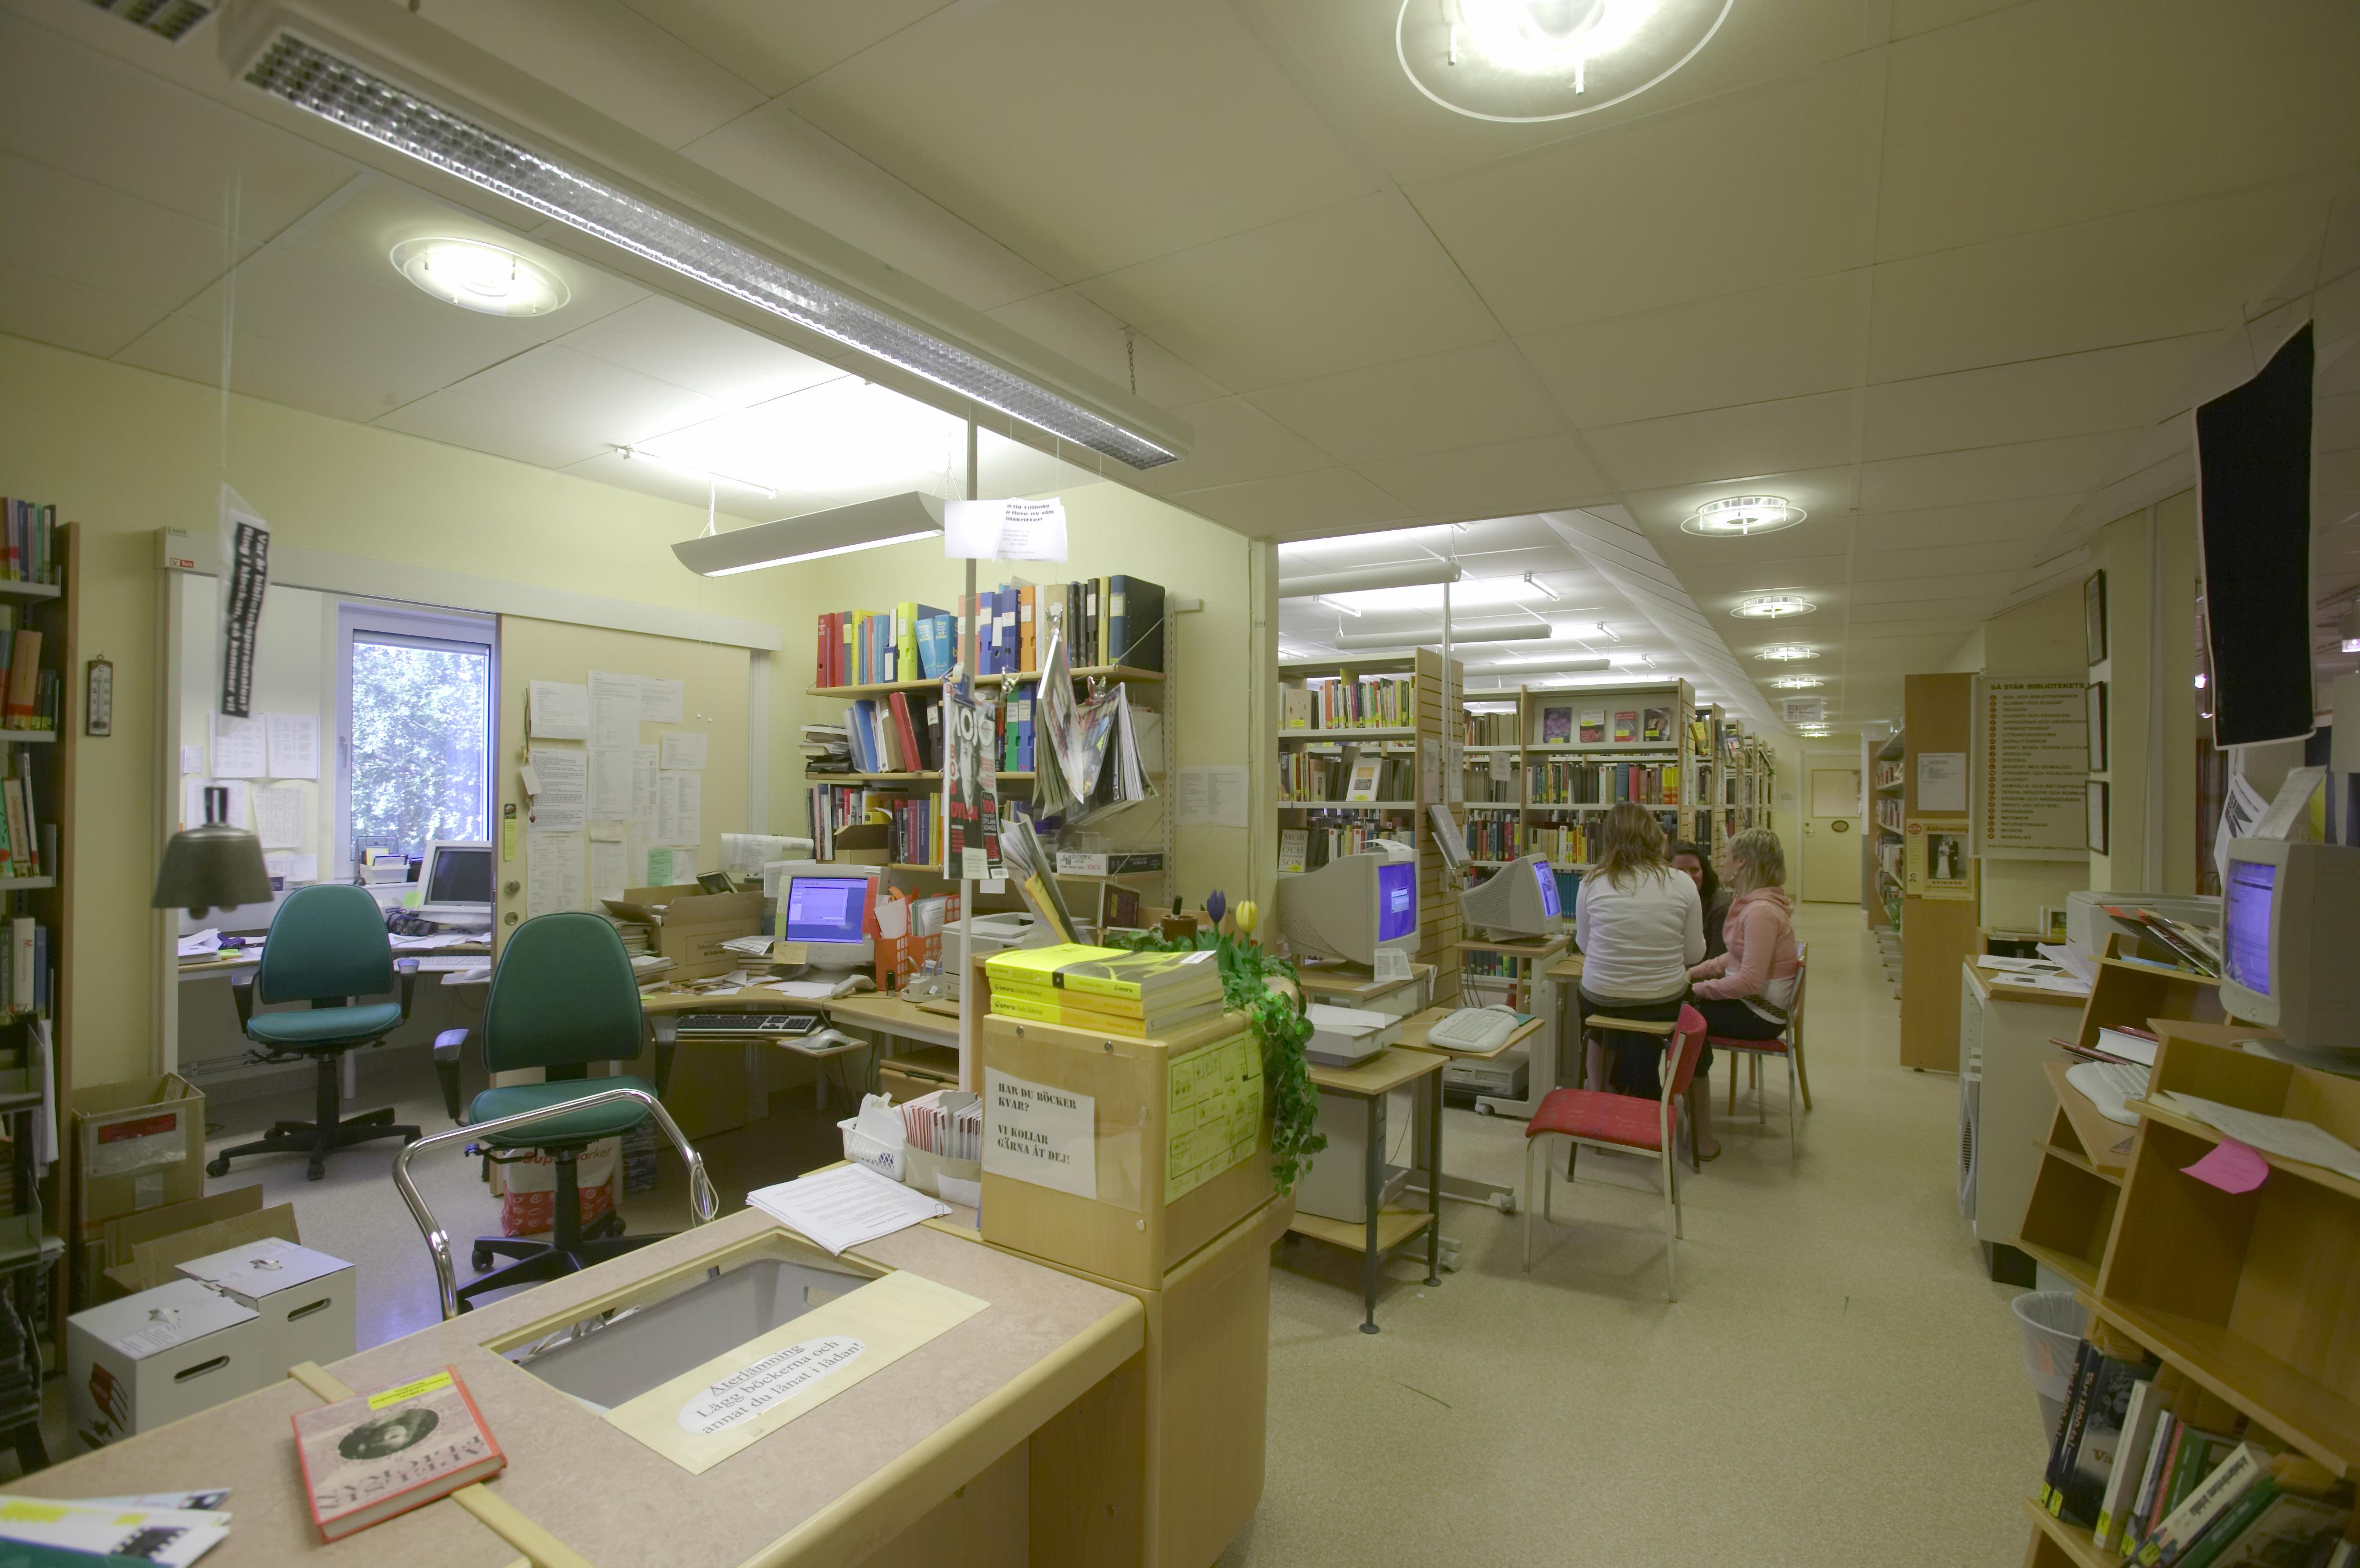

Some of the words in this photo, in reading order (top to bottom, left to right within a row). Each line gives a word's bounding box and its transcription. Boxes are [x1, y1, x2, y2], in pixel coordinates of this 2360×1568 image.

[239, 526, 254, 556] Ring
[256, 535, 267, 556] Var
[233, 565, 251, 618] klockan,
[239, 574, 265, 711] bibliotekspersonalen?
[228, 641, 240, 692] kommer
[951, 800, 979, 821] DYLAN
[983, 799, 995, 814] 100
[983, 818, 996, 826] DYLAN
[983, 823, 997, 831] SONGS
[1284, 833, 1305, 841] MOR
[1282, 846, 1304, 854] OCH
[998, 1083, 1018, 1096] HAR
[1021, 1088, 1034, 1099] DU
[1037, 1091, 1077, 1109] BÖCKER
[998, 1097, 1029, 1112] KVAR?
[998, 1124, 1007, 1135] VI
[1011, 1128, 1048, 1145] KOLLAR
[998, 1137, 1029, 1155] GÄRNA
[1032, 1145, 1045, 1158] ÅT
[1048, 1151, 1070, 1164] DEJ!
[696, 1393, 744, 1418] Lägg
[740, 1355, 812, 1393] böckerna
[813, 1341, 839, 1357] och
[703, 1406, 750, 1434] annat
[751, 1393, 772, 1408] du
[770, 1372, 812, 1394] lånat
[818, 1343, 864, 1368] lådan!
